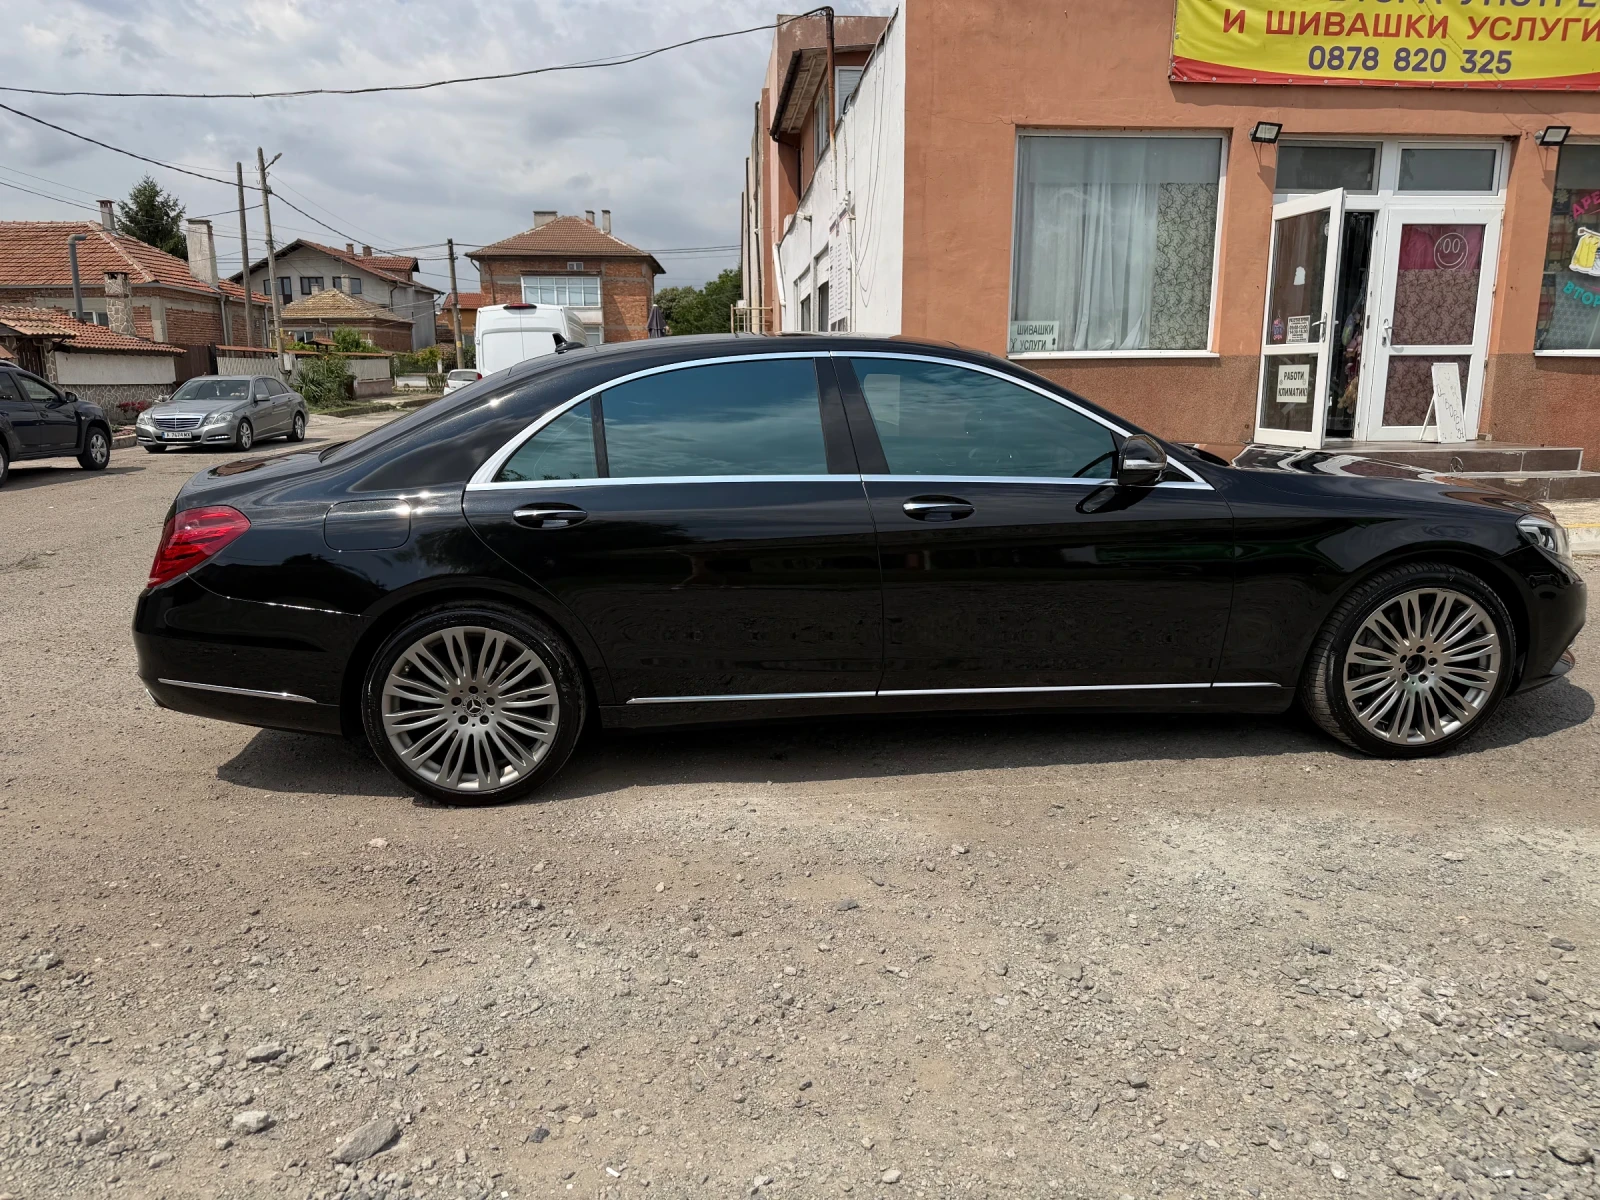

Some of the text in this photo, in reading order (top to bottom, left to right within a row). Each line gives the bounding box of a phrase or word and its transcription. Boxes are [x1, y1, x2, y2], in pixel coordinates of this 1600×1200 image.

[1223, 9, 1600, 42] И ШИВАШКИ УСЛУГИ
[1308, 45, 1512, 74] 0878 820 325
[1017, 324, 1054, 336] ШИВАШКИ
[1020, 340, 1046, 350] УСЛУГИ
[1284, 371, 1304, 380] РАБОТИ
